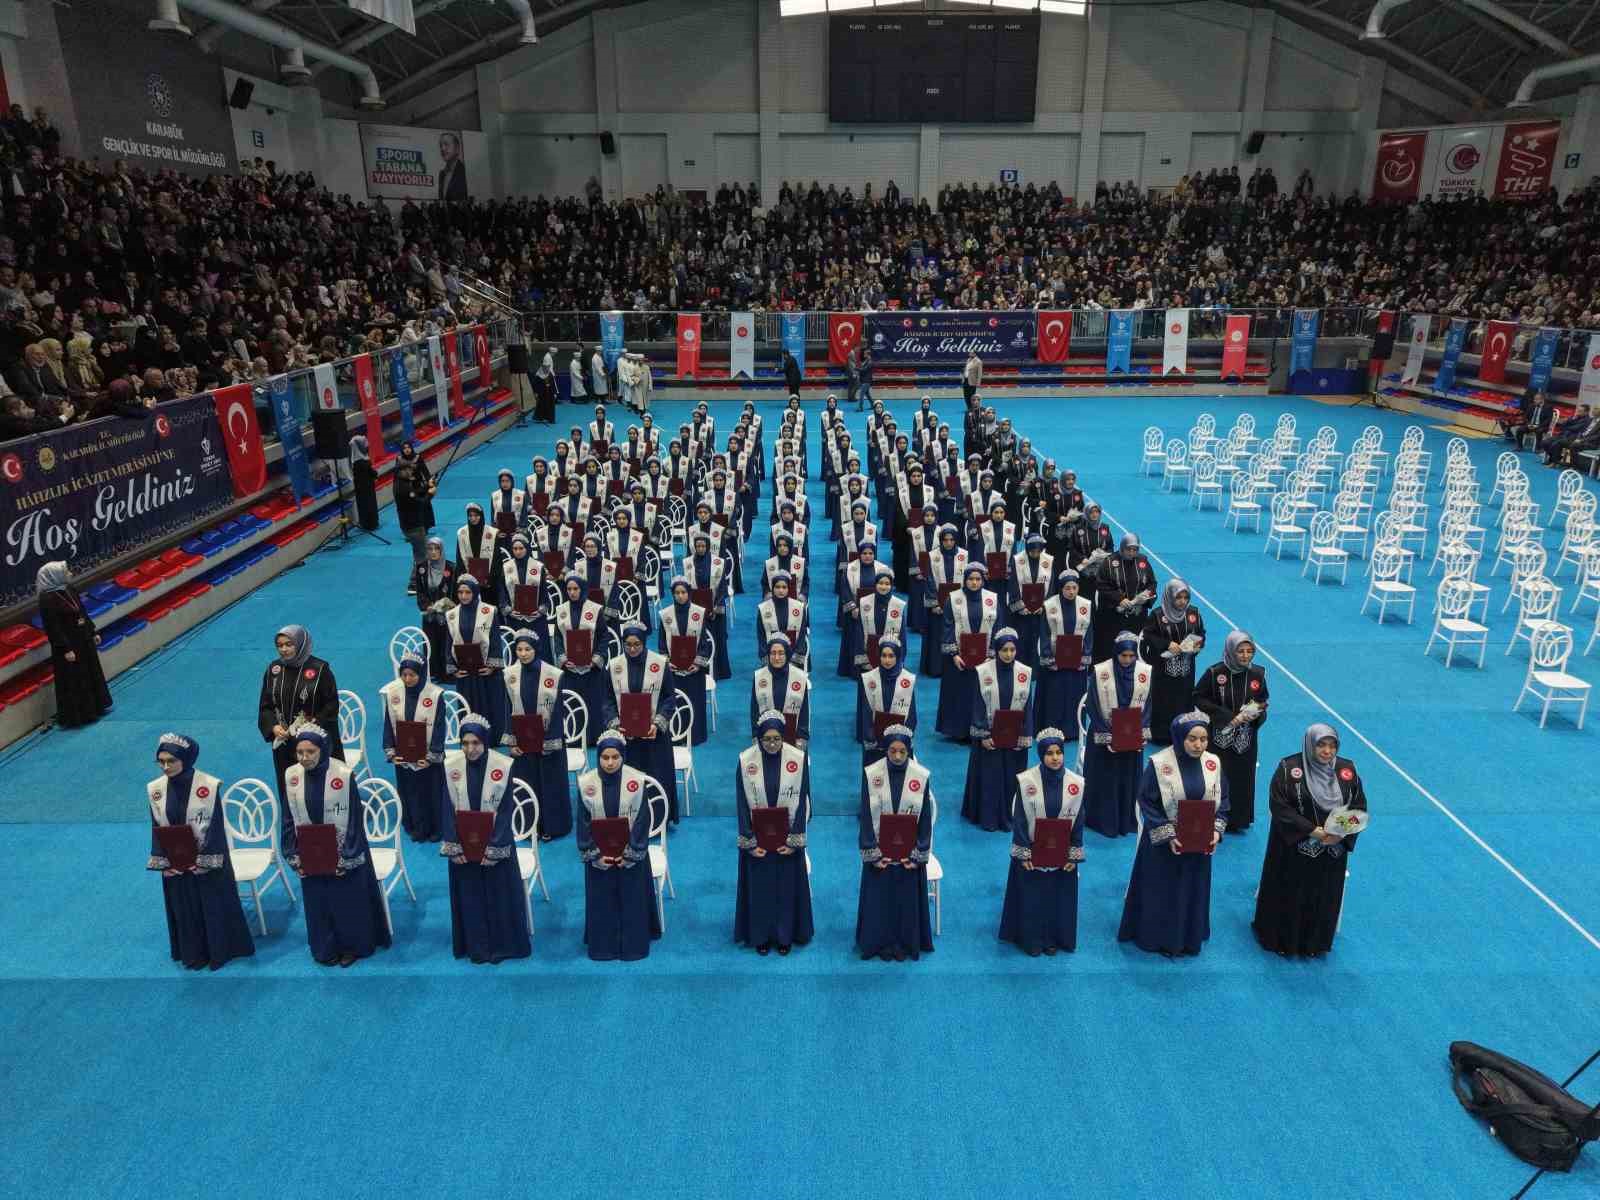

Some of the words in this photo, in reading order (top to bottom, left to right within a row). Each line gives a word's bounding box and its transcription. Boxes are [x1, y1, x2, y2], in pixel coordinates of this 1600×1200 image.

[146, 120, 185, 140] KARABÜK
[103, 136, 140, 157] GENÇLİK
[140, 143, 152, 157] VE
[152, 146, 172, 160] SPOR
[172, 145, 180, 160] İL
[181, 148, 226, 168] MÜDÜRLÜĞÜ
[381, 150, 416, 162] SPORU
[374, 172, 433, 186] YAYIYORUZ
[1503, 176, 1544, 192] THF
[893, 336, 930, 358] Hoş
[936, 336, 1004, 353] Geldiniz
[6, 508, 79, 566] Hoş
[92, 468, 195, 531] Geldiniz
